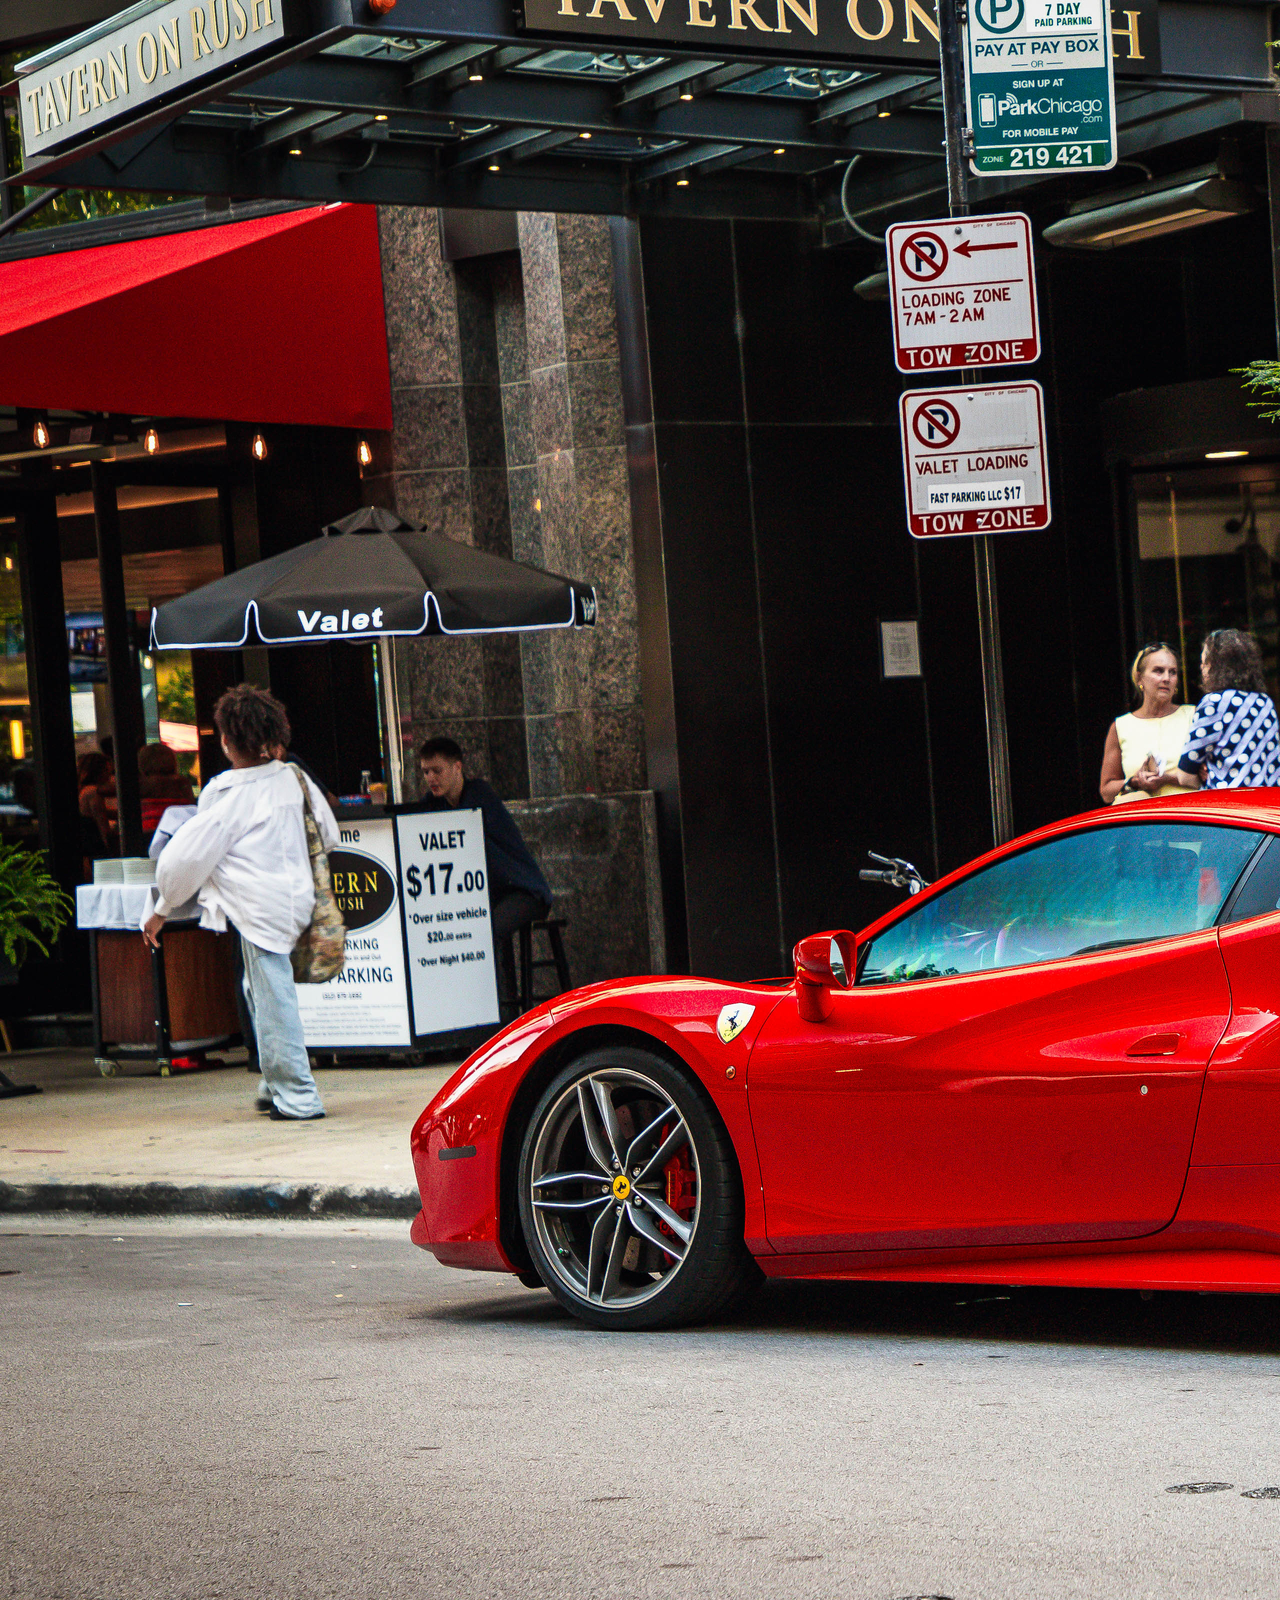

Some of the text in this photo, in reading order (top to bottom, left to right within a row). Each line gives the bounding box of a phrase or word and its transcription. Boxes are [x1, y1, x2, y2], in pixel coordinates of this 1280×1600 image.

[1045, 3, 1081, 16] 7 DAY
[846, 0, 941, 43] ON
[1035, 16, 1092, 27] PAID PARKING
[975, 39, 1099, 57] PAY AT PAY BOX
[26, 0, 276, 137] TAVERN ON RUSH
[1031, 60, 1044, 68] OR
[1012, 78, 1064, 89] SIGN UP AT
[998, 97, 1103, 116] ParkChicago
[1002, 127, 1079, 138] FOR MOBILE PAY
[1010, 147, 1050, 167] 219
[1055, 145, 1093, 165] 421
[902, 287, 1011, 309] LOADING ZONE
[906, 342, 1024, 367] TOW ZONE
[915, 454, 1029, 475] VALET LOADING
[930, 486, 1021, 504] FAST PARKING LLC $17
[919, 508, 1036, 533] TOW ZONE
[297, 607, 383, 633] Valet
[419, 830, 466, 851] VALET
[333, 871, 378, 894] ERN
[406, 863, 485, 902] $17.00
[338, 896, 364, 911] USH
[436, 911, 453, 921] size
[456, 906, 487, 919] vehicle
[345, 938, 379, 950] RKING
[440, 954, 459, 966] Night
[330, 966, 393, 984] ARKING
